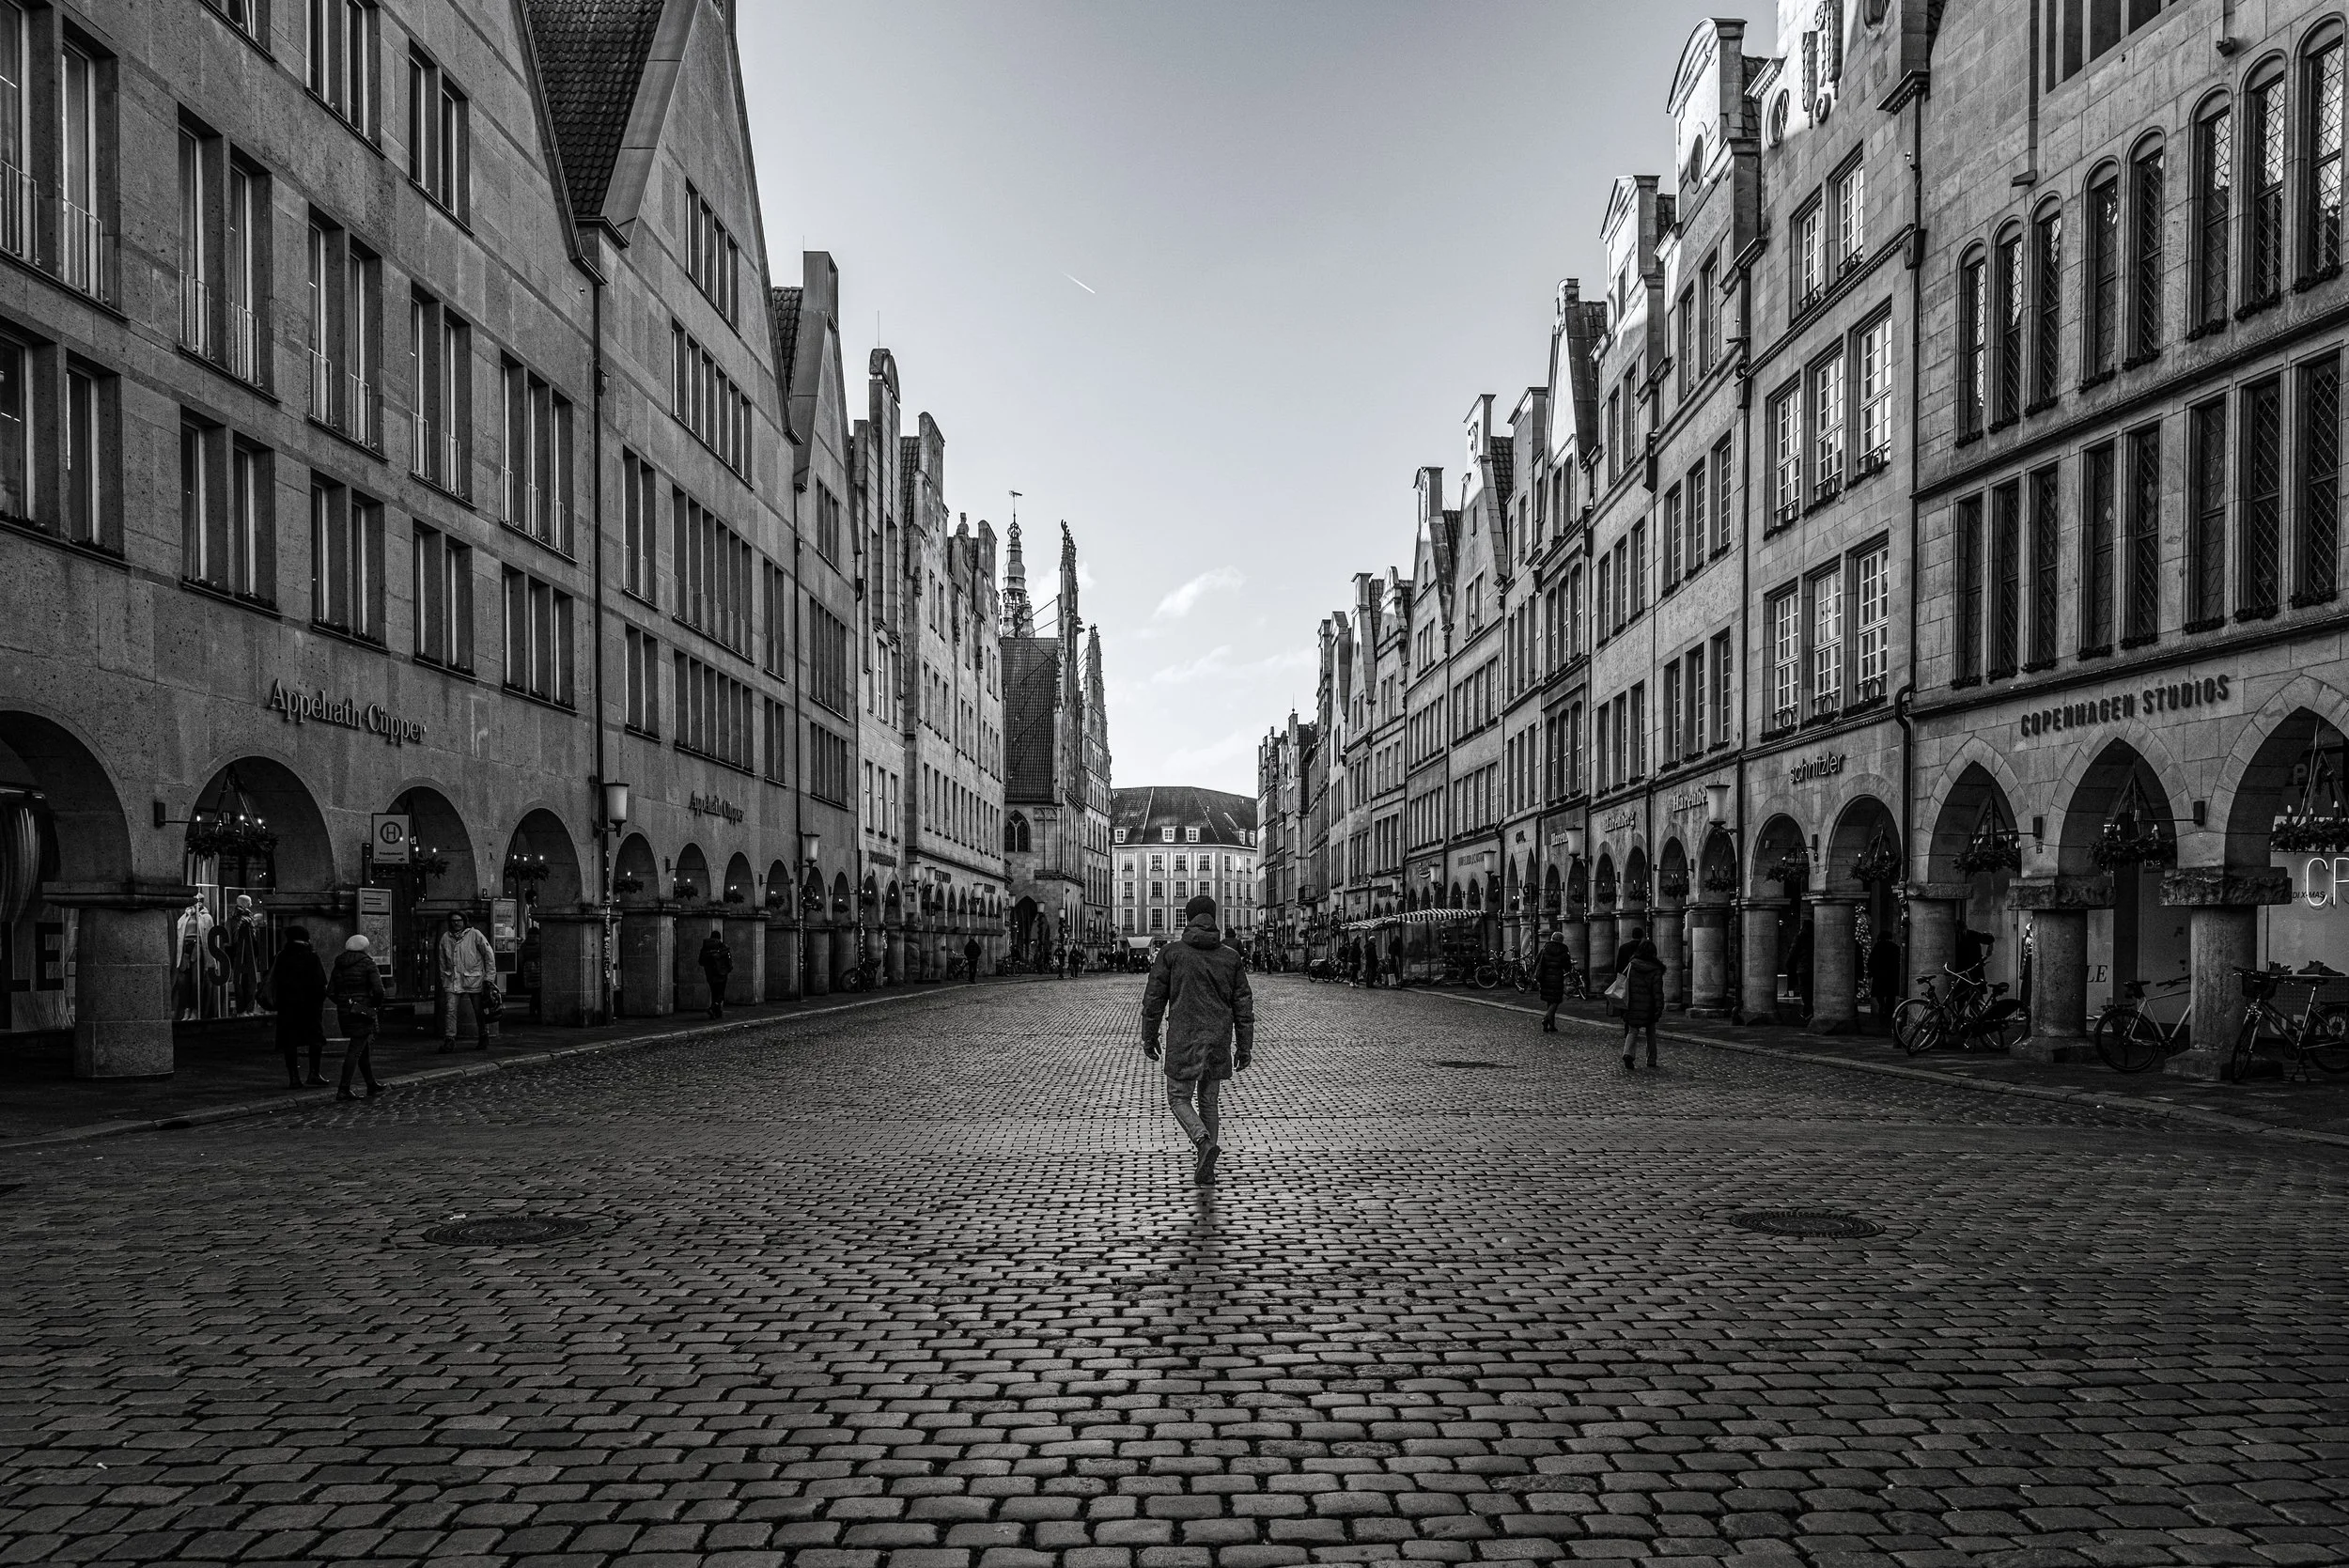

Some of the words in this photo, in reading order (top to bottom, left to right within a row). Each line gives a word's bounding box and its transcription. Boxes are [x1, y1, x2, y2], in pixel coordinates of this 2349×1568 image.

[270, 677, 428, 745] Appelrath-Cüpper
[2021, 693, 2135, 737] COPENHAGEN
[2142, 674, 2230, 715] STUDIOS
[1790, 751, 1844, 784] schnitzler
[1672, 787, 1709, 814] Harenbe
[386, 826, 397, 840] H
